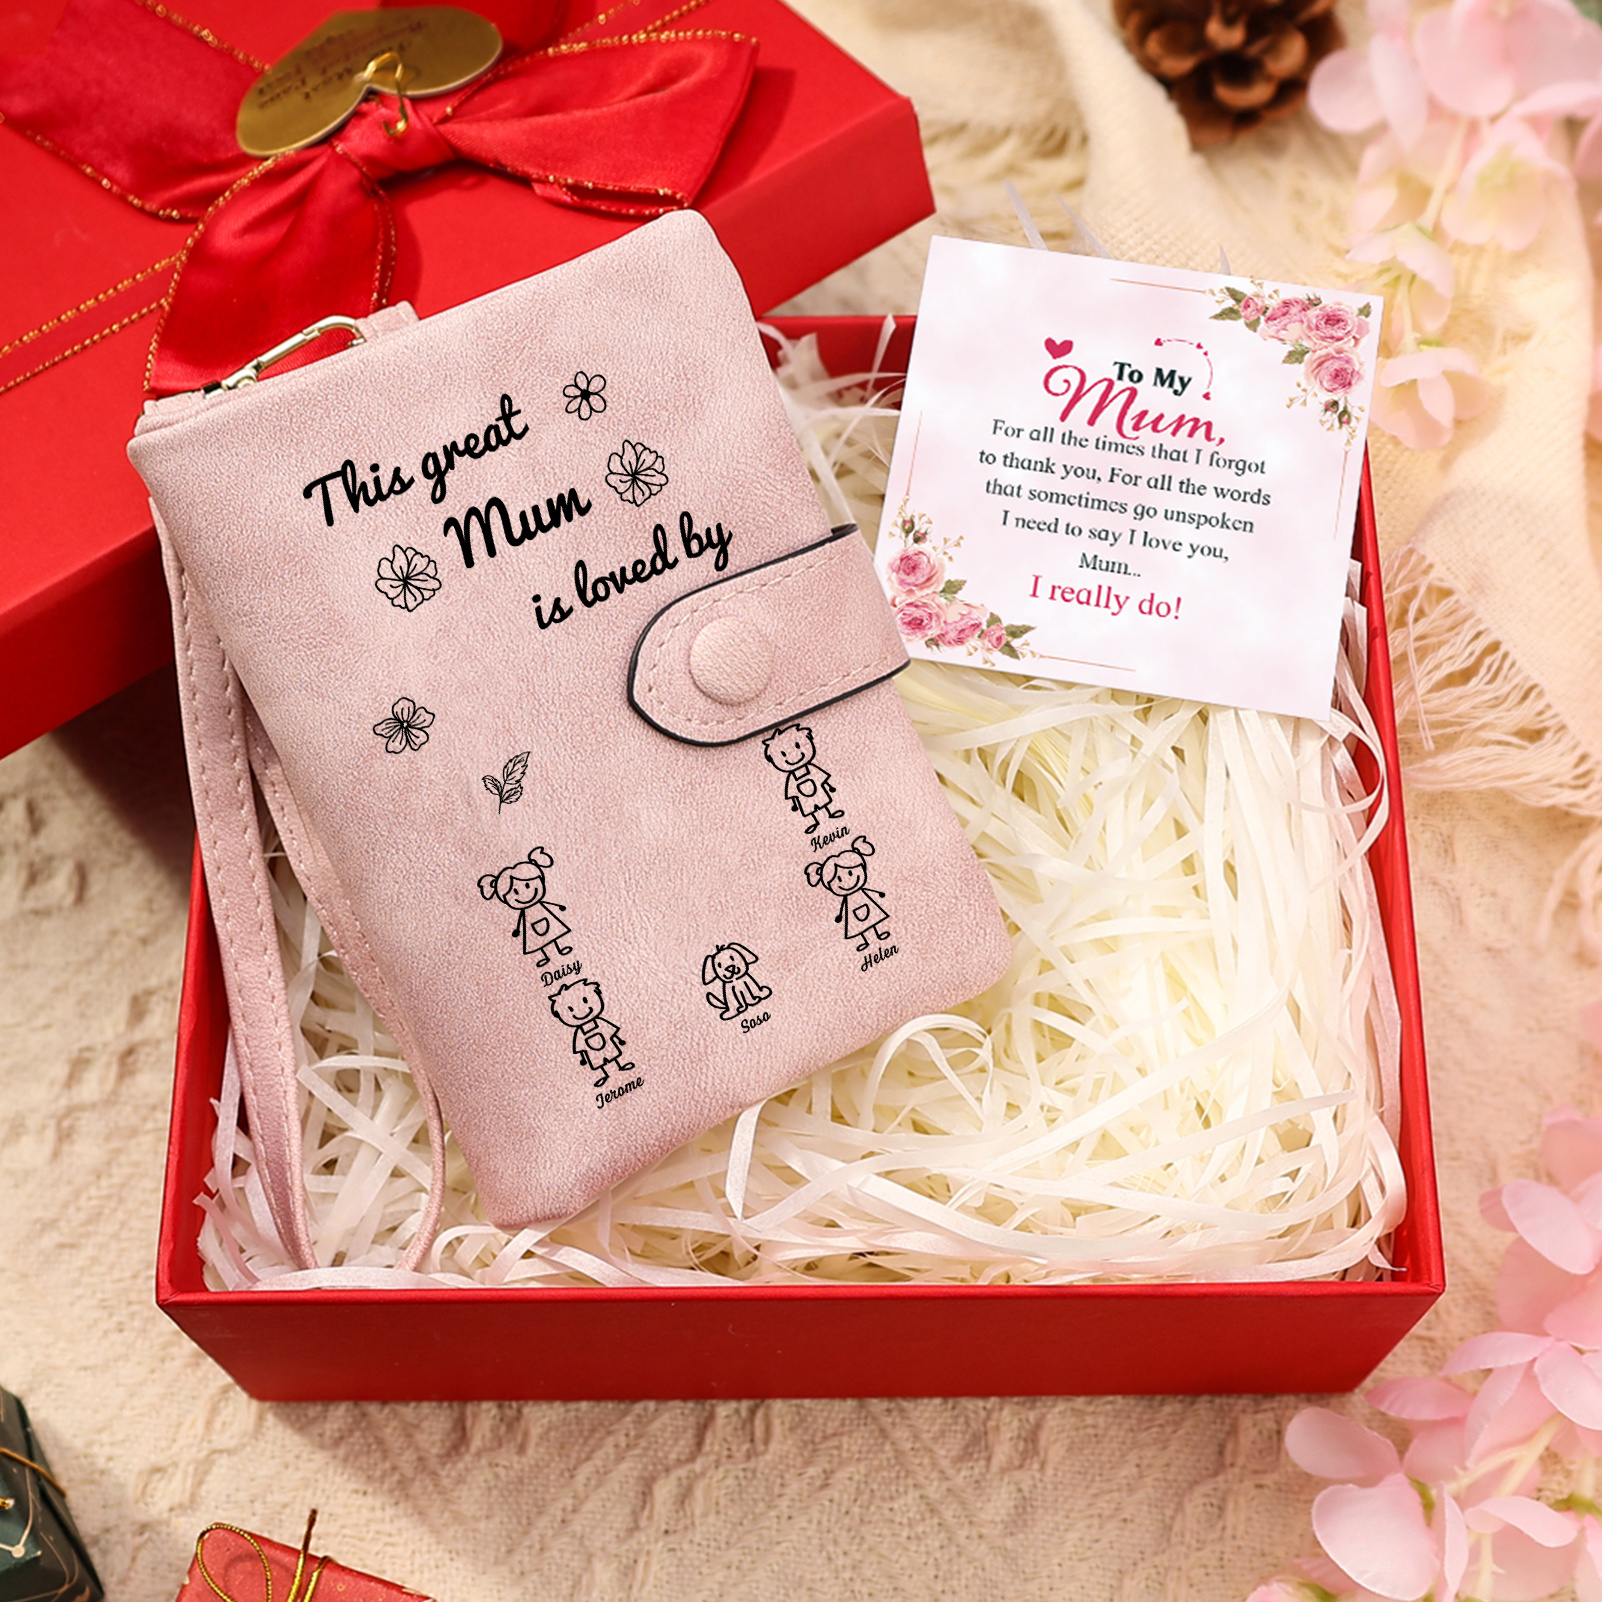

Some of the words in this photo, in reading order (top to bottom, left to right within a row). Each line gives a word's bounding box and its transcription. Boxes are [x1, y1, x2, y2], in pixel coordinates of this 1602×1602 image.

[1112, 361, 1144, 384] To
[1153, 366, 1193, 397] My
[1043, 364, 1226, 447] Mum,
[302, 458, 416, 527] This
[420, 393, 530, 505] great
[992, 418, 1025, 438] For
[1029, 426, 1055, 443] all
[1061, 430, 1089, 448] the
[1095, 435, 1145, 456] times
[1151, 443, 1188, 463] that
[1195, 449, 1203, 465] I
[1208, 451, 1266, 477] forgot
[979, 449, 997, 465] to
[1002, 452, 1056, 474] thank
[1062, 463, 1102, 484] you,
[1108, 467, 1142, 487] For
[1146, 474, 1172, 491] all
[1178, 478, 1207, 496] the
[1213, 488, 1272, 506] words
[443, 487, 593, 569] Mum
[985, 478, 1022, 499] that
[1028, 491, 1128, 514] sometimes
[1133, 503, 1158, 521] go
[1164, 512, 1254, 533] unspoken
[1002, 509, 1010, 526] I
[1015, 517, 1059, 534] need
[1065, 522, 1083, 537] to
[1088, 528, 1123, 547] say
[1129, 528, 1137, 545] I
[1142, 531, 1183, 552] love
[1187, 542, 1229, 563] you,
[531, 593, 574, 630] is
[573, 523, 680, 609] loved
[679, 510, 734, 573] by
[1078, 552, 1141, 577] Mum...
[1029, 574, 1043, 598] I
[1048, 584, 1130, 616] really
[1138, 592, 1182, 620] do!
[810, 826, 851, 853] Kevin
[540, 960, 583, 988] Daisy
[860, 945, 900, 973] Helen
[740, 1011, 772, 1034] Soso
[595, 1076, 645, 1110] Jerome
